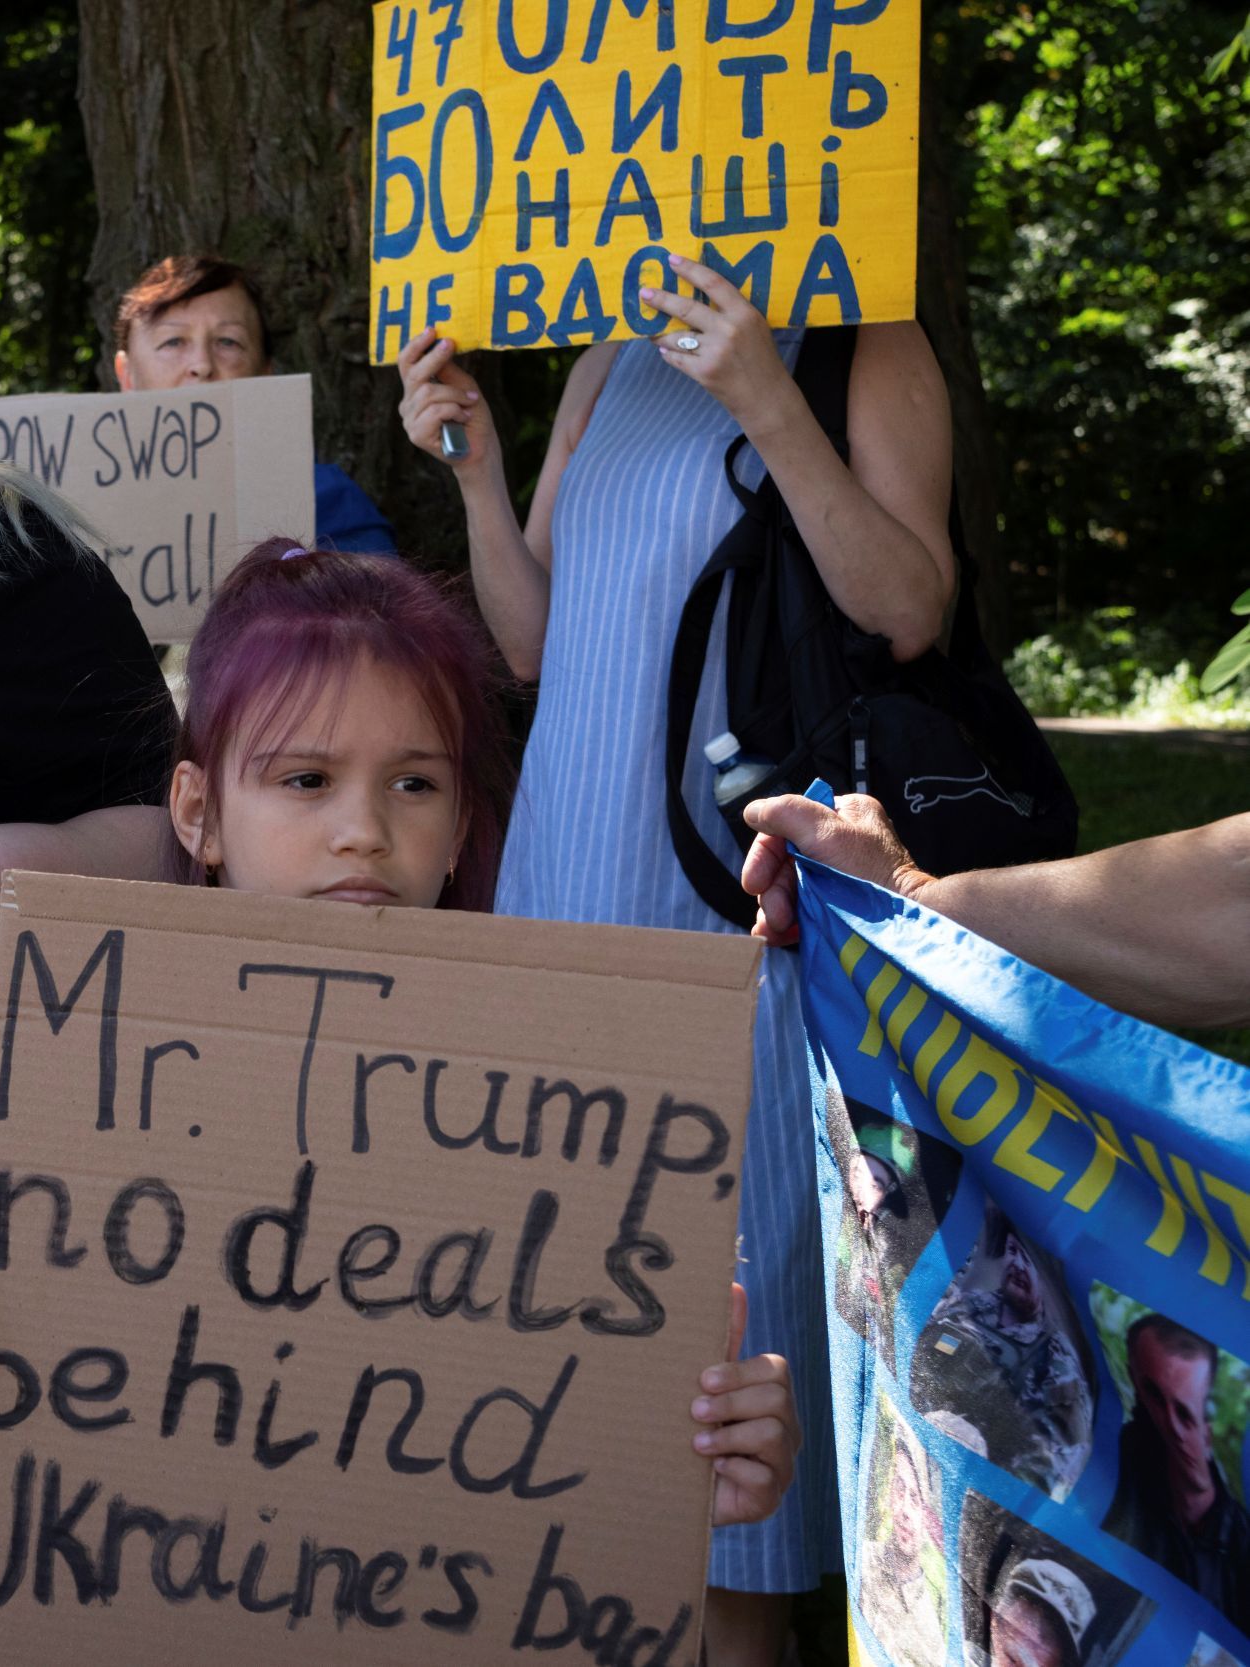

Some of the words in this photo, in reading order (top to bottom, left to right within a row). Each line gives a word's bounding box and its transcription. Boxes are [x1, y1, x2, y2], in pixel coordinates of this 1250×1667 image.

[387, 0, 464, 95] 47
[516, 135, 842, 252] НАШІ
[376, 273, 454, 363] НЕ
[491, 233, 863, 348] ВДОМА
[239, 963, 737, 1243] Trump,
[220, 1159, 676, 1338] deals
